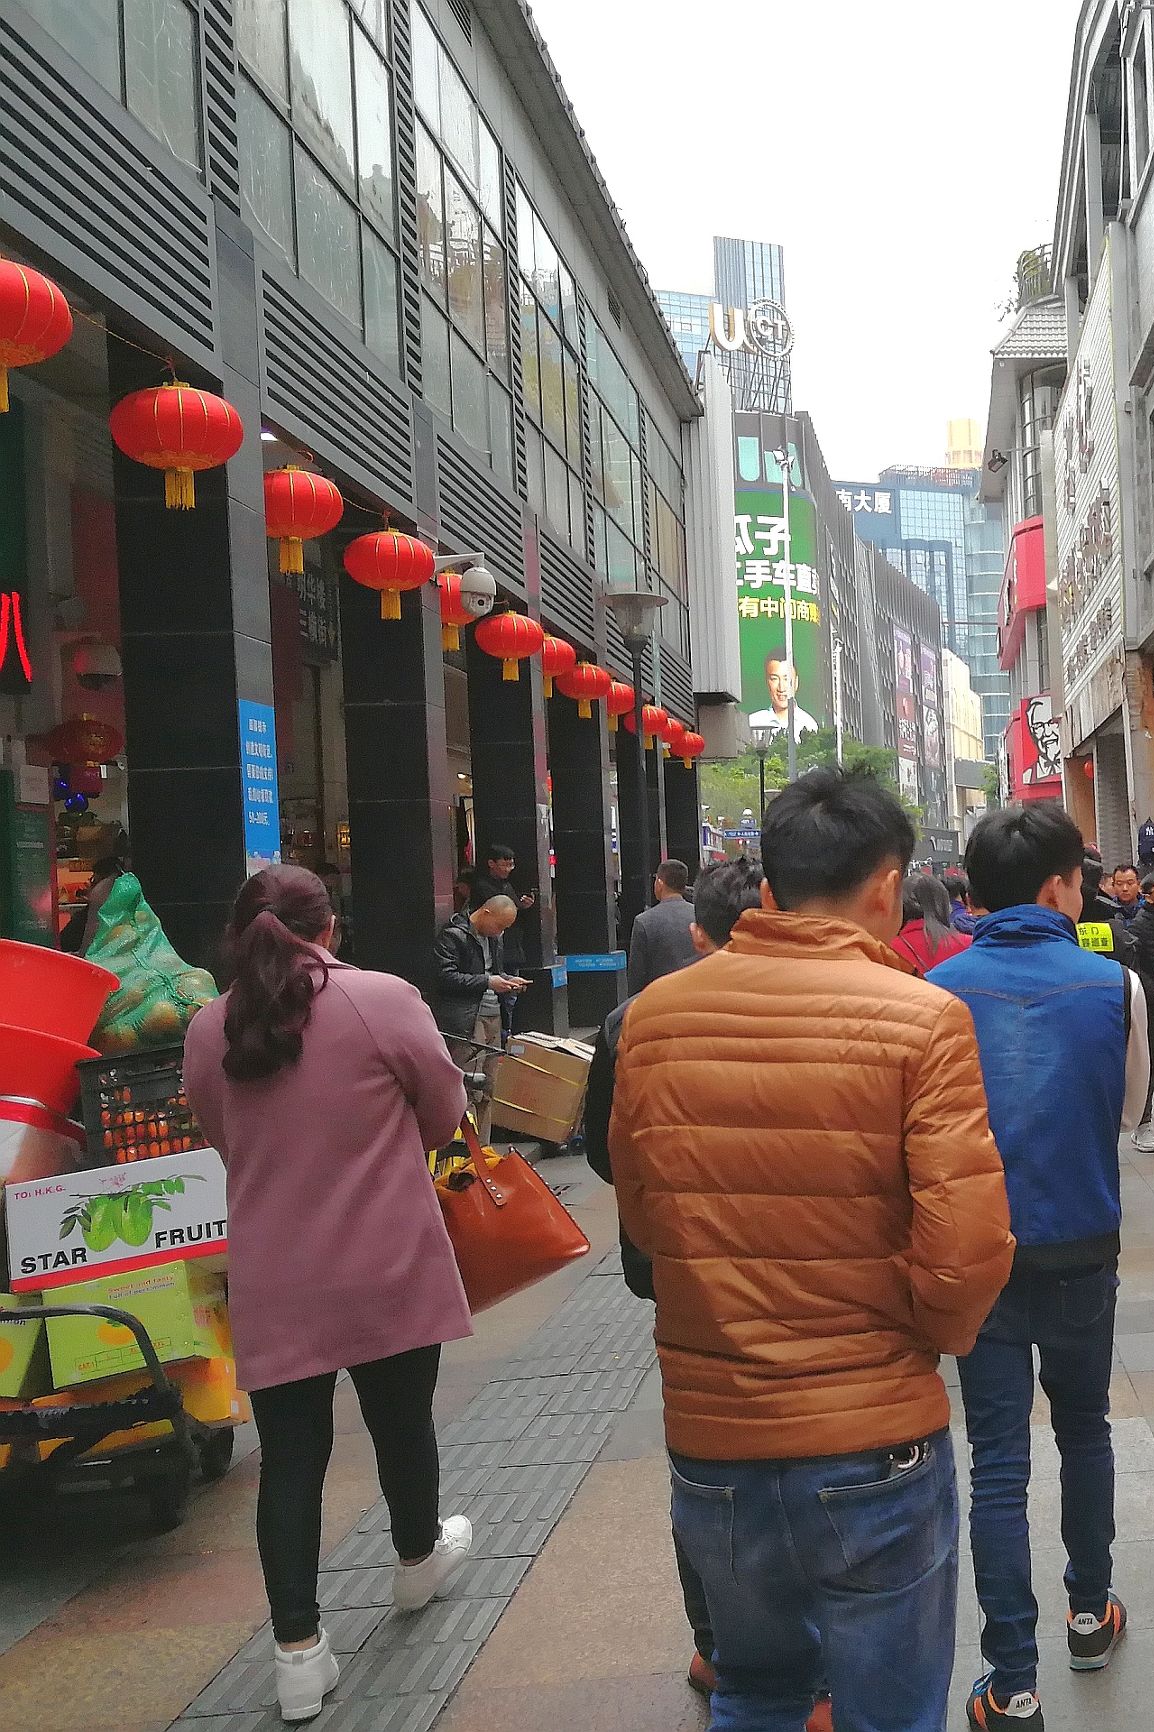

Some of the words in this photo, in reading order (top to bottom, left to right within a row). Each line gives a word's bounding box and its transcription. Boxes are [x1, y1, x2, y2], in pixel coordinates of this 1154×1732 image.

[20, 1246, 88, 1275] STAR
[154, 1218, 227, 1249] FRUIT
[1078, 1617, 1093, 1626] ANTA
[1015, 1697, 1033, 1709] ANTA
